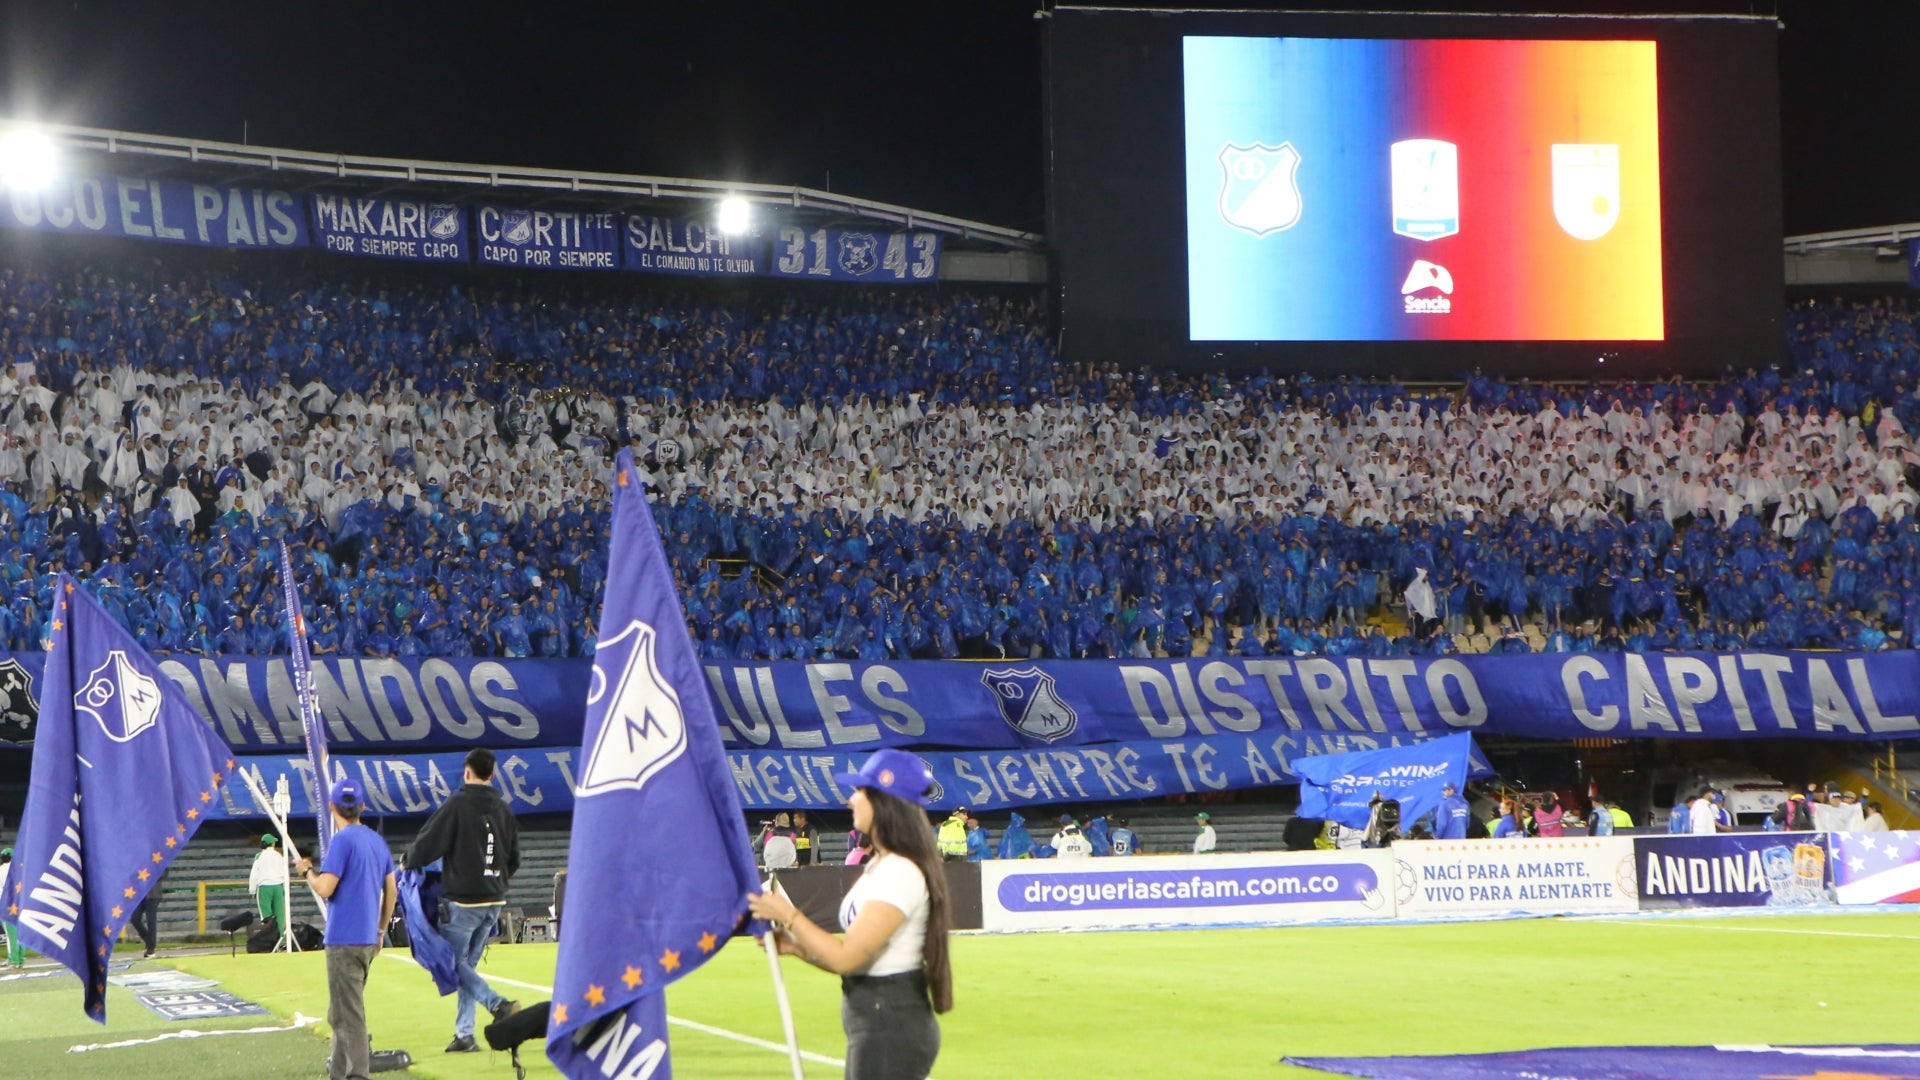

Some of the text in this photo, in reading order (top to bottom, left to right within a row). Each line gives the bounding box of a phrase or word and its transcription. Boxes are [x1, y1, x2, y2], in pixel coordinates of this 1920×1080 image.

[117, 176, 186, 240] EL
[193, 184, 299, 246] PAIS
[585, 213, 613, 230] PTE
[326, 234, 459, 259] POR SIEMPRE CAPO
[483, 245, 614, 268] CAPO POR SIEMPRE
[778, 226, 937, 279] 31 43
[642, 253, 755, 273] EL COMANDO NO TE OLVIDA
[157, 658, 540, 744] OMANDOS
[1119, 658, 1488, 738] DISTRITO
[1561, 652, 1920, 735] CAPITAL
[953, 746, 1157, 806] SIEMPRE
[1162, 743, 1229, 793] TE
[1423, 860, 1590, 881] NACÍ PARA AMARTE,
[1646, 849, 1768, 895] ANDINA
[1024, 875, 1339, 905] drogueriascafam.com.co
[1424, 882, 1612, 902] VIVO PARA ALENTARTE
